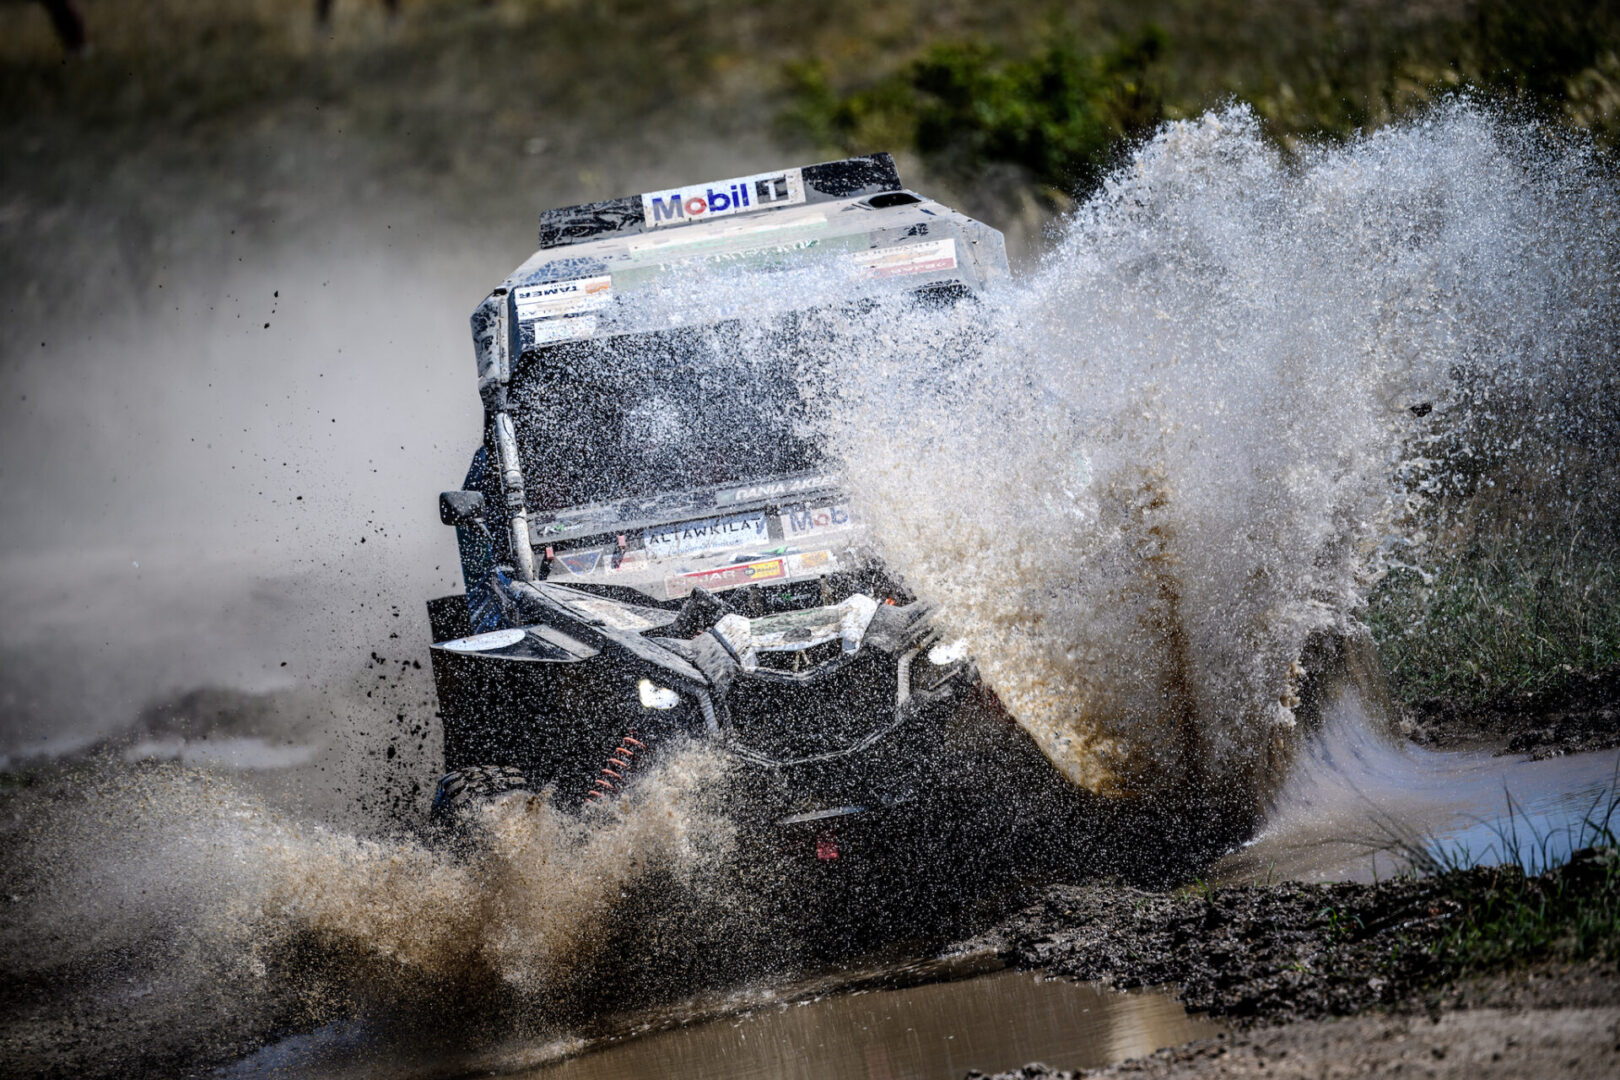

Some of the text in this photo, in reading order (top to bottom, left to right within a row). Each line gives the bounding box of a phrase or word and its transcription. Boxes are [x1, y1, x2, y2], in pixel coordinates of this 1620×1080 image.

[651, 182, 749, 222] Mobil
[735, 484, 785, 501] DANIA
[649, 516, 761, 545] ALTAWKILAT
[785, 503, 848, 532] Mob
